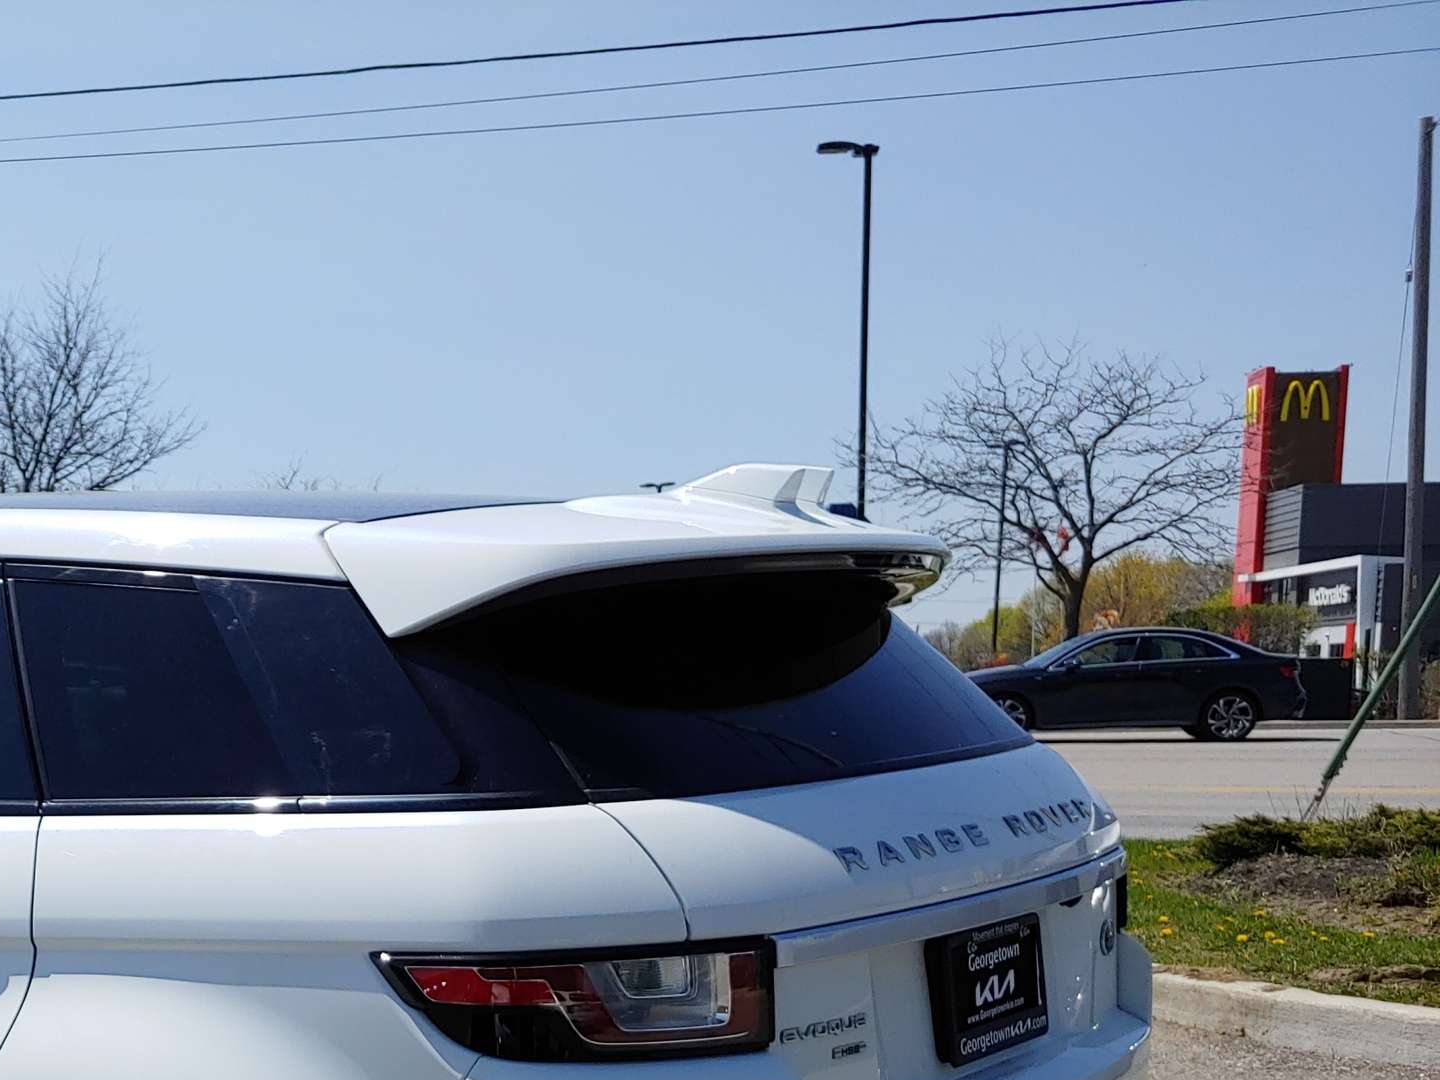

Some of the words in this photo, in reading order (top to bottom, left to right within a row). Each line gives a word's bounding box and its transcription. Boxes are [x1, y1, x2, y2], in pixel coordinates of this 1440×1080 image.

[833, 822, 990, 873] RANGE
[1002, 799, 1092, 838] ROVER
[968, 943, 1020, 971] Georgetown
[779, 1012, 866, 1044] EVOQUE
